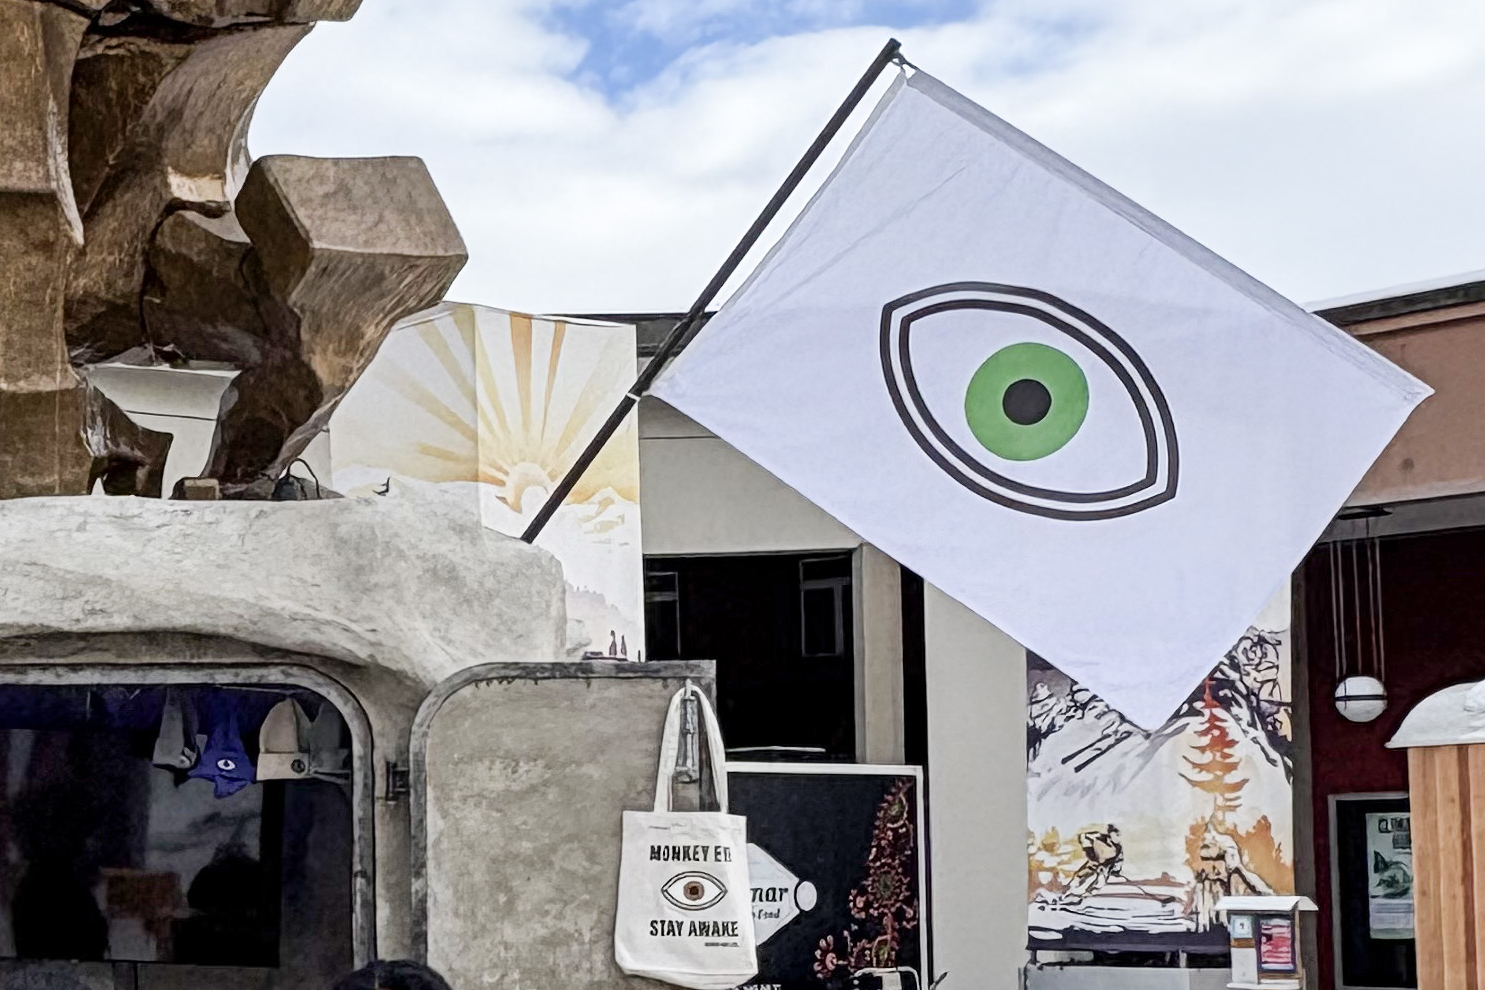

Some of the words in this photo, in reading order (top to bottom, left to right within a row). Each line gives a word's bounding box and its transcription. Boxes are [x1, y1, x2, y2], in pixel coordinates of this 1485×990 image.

[650, 845, 709, 861] MONKEY
[650, 920, 684, 936] STAY
[688, 921, 738, 937] AWAKE
